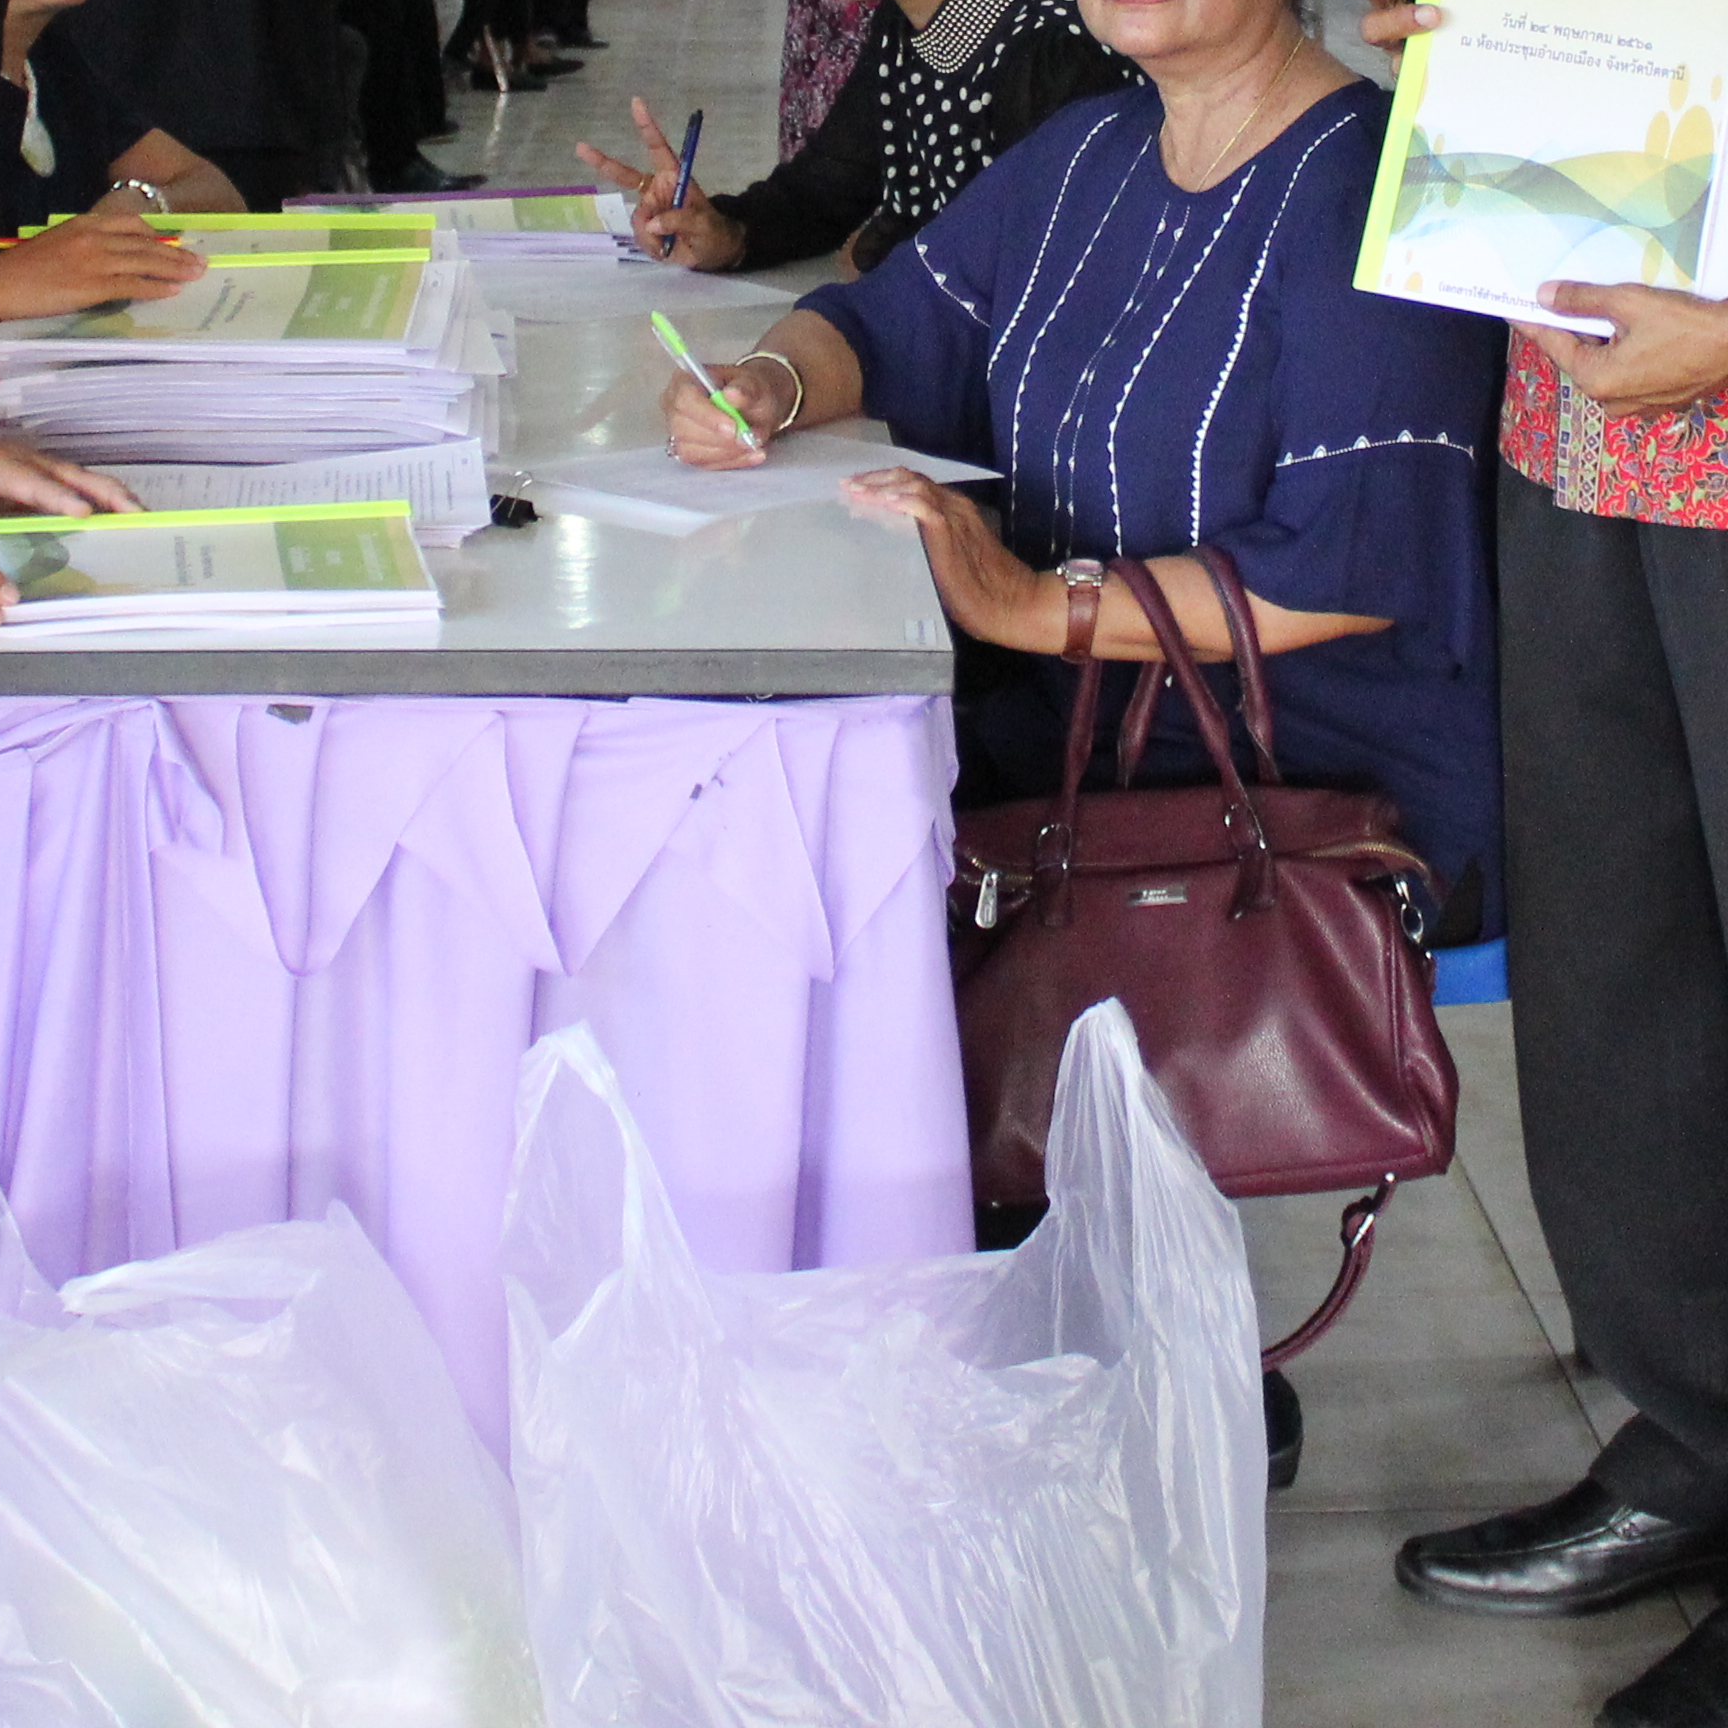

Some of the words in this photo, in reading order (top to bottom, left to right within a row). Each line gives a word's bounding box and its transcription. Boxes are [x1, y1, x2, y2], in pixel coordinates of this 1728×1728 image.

[1502, 12, 1528, 31] วันที่
[1554, 23, 1613, 45] พฤษภาคม
[1460, 34, 1473, 47] ณ
[1476, 32, 1602, 69] ห้องประชุมอำเภอเมือง
[1606, 54, 1687, 81] จังหวัดปัตตานี
